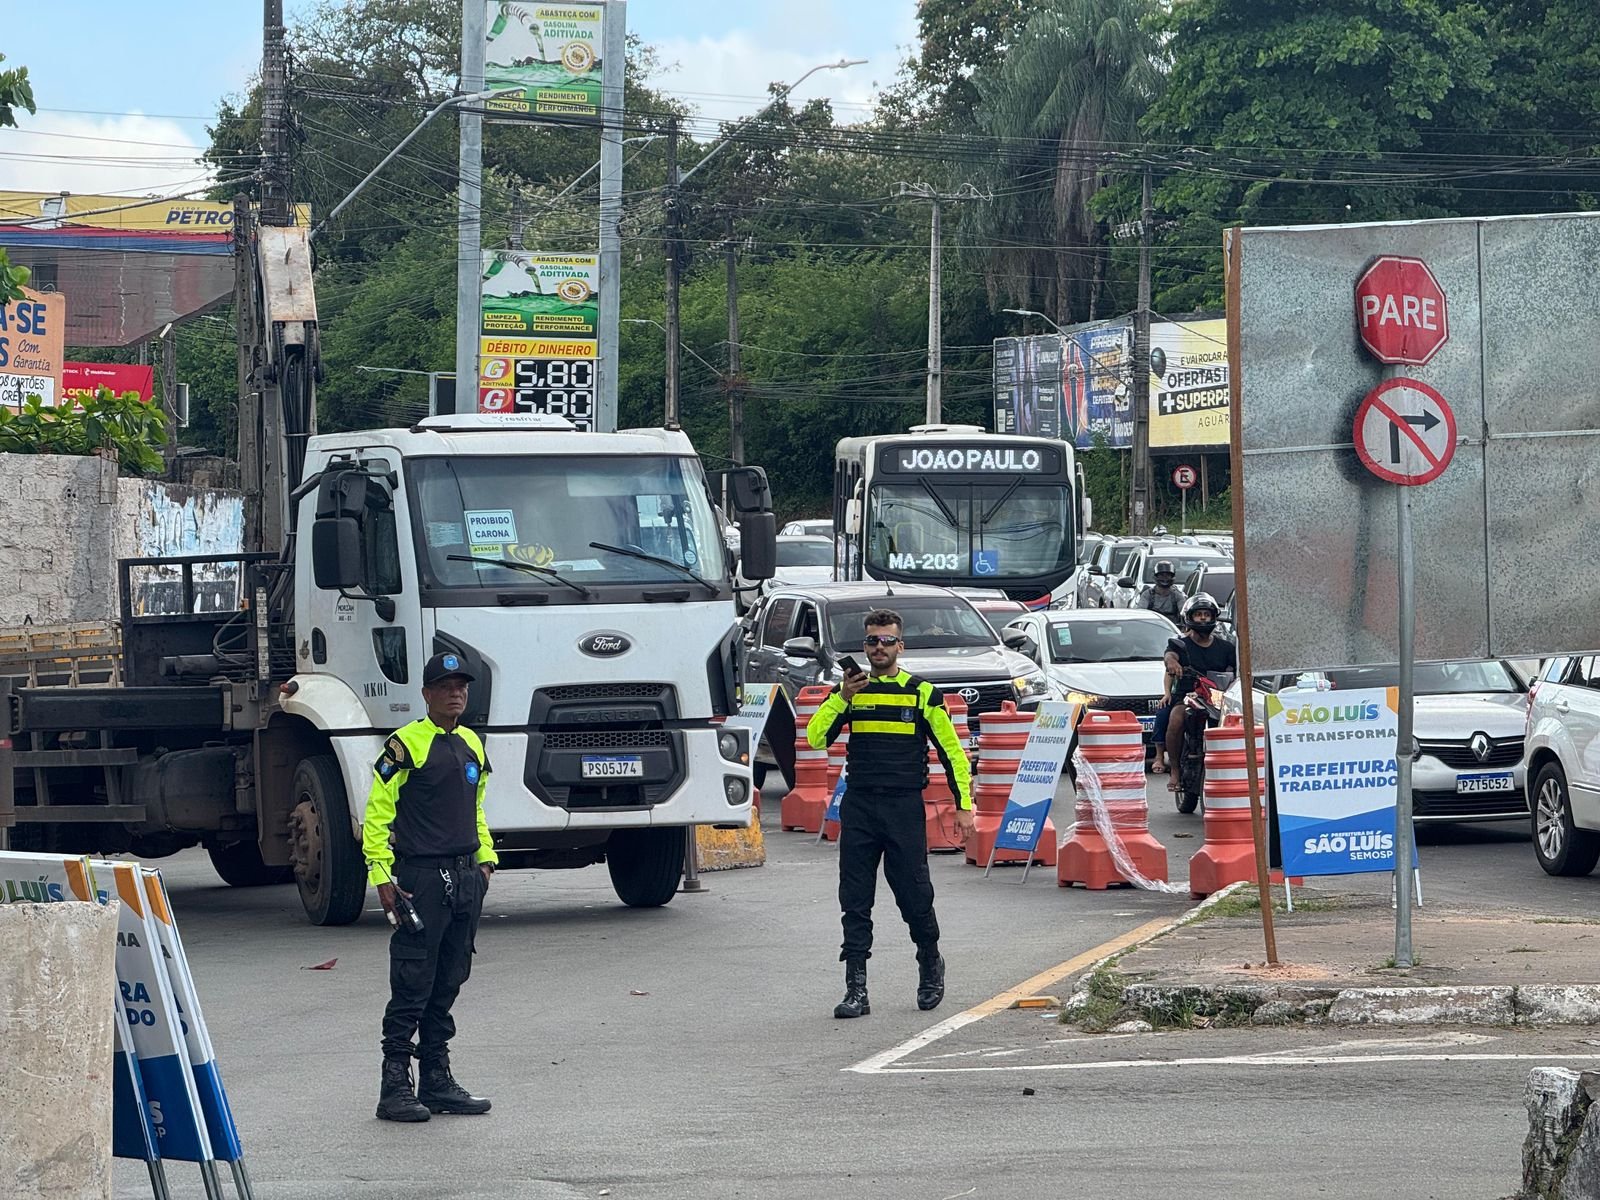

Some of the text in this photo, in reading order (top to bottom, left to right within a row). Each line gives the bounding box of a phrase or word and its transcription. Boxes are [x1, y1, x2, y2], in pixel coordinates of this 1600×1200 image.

[540, 10, 577, 19] ABASTEÇA
[543, 21, 577, 29] GASOLINA
[543, 29, 594, 39] ADITIVADA
[538, 92, 586, 101] RENDIMENTO
[538, 104, 594, 113] PERFORMANCE
[165, 210, 235, 225] PETRO
[1362, 294, 1437, 331] PARE
[486, 321, 524, 330] PROTEÇÃO
[535, 324, 591, 332] PERFORMANCE
[18, 339, 41, 354] Com
[487, 340, 527, 354] DÉBITO
[538, 345, 592, 355] DINHEIRO
[13, 354, 51, 372] Garantia
[1186, 354, 1198, 365] VAI
[1198, 351, 1222, 363] ROLAR
[516, 360, 593, 388] 5,80
[1167, 367, 1221, 389] OFERTAS
[10, 375, 45, 390] CARTÕES
[902, 449, 1040, 470] JOAO PAULO
[1180, 469, 1189, 484] E
[470, 516, 510, 525] PROIBIDO
[475, 529, 510, 538] CARONA
[889, 553, 959, 571] MA-203
[592, 636, 622, 651] Ford
[1285, 699, 1380, 725] SÃO LUÍS
[1036, 735, 1067, 745] TRANSFORMA
[1275, 728, 1397, 744] SE TRANSFORMA
[1020, 760, 1058, 773] PREFEITURA
[1278, 759, 1398, 779] PREFEITURA
[1016, 773, 1054, 785] TRABALHANDO
[1280, 775, 1398, 793] TRABALHANDO
[1462, 778, 1509, 792] PZT5C52
[1304, 830, 1393, 854] SÃO LUÍS
[1350, 850, 1394, 860] SEMOSP
